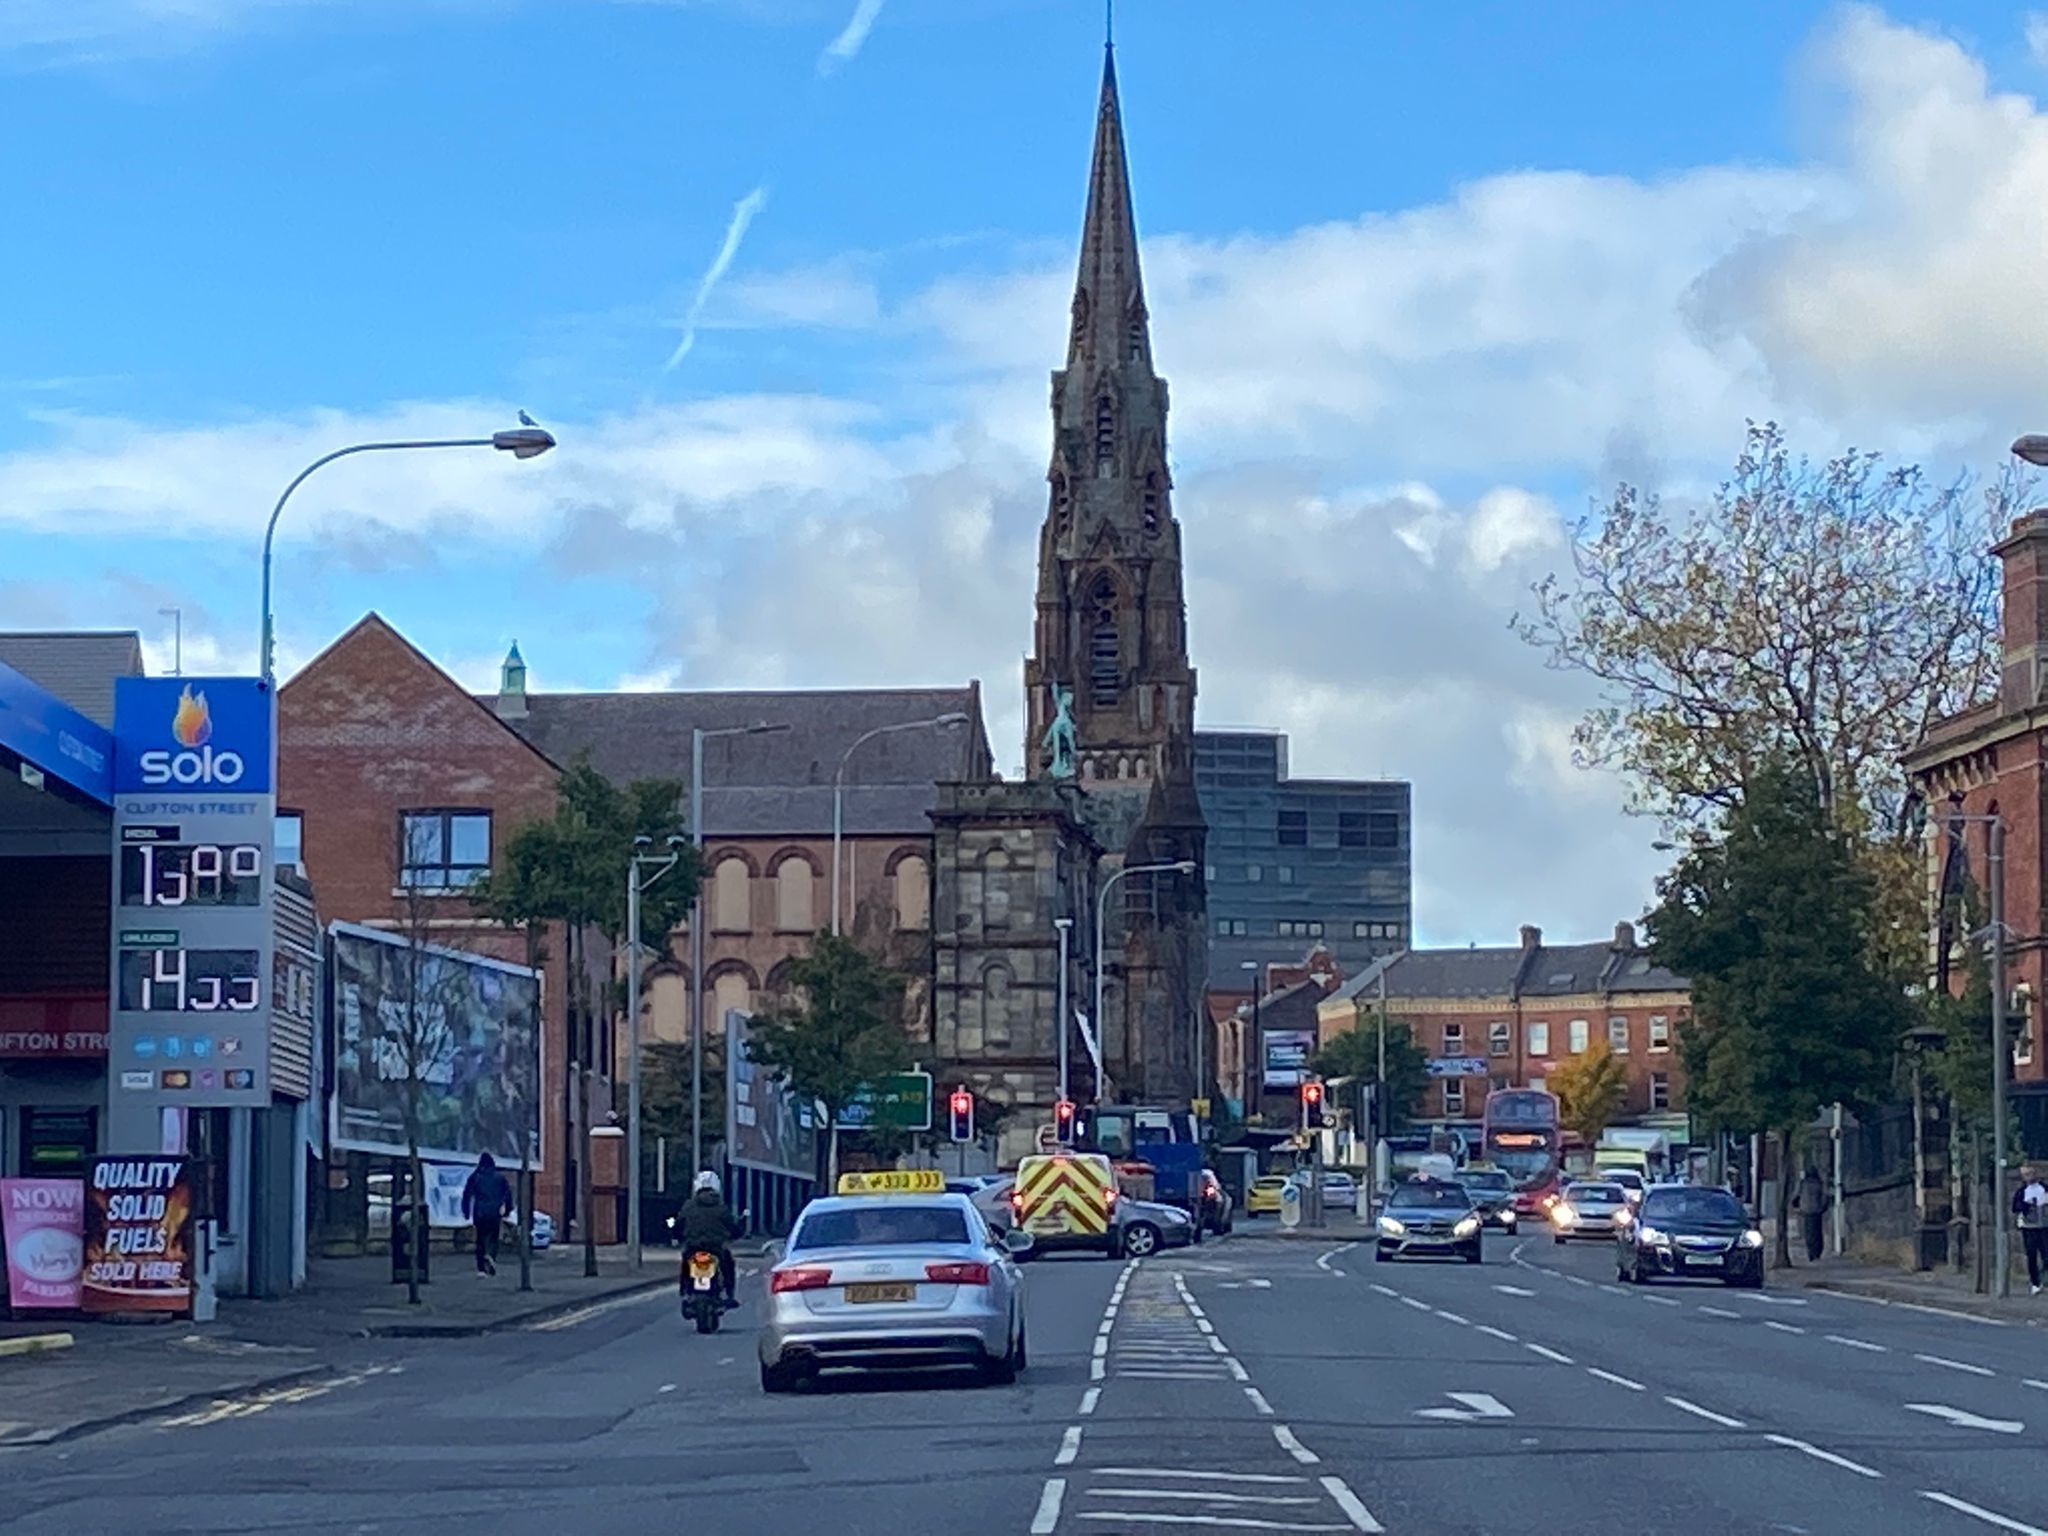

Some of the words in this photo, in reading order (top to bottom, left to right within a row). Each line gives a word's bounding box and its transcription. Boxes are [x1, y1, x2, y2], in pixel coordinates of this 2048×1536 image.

[140, 745, 244, 784] solo
[125, 802, 195, 815] CLIFTON
[199, 802, 257, 815] STREET
[93, 1162, 182, 1189] QUALITY
[11, 1187, 78, 1209] NOW
[107, 1195, 166, 1221] SOLID
[105, 1227, 167, 1254] FUELS
[90, 1261, 136, 1280] SOLD
[139, 1261, 183, 1280] HERE
